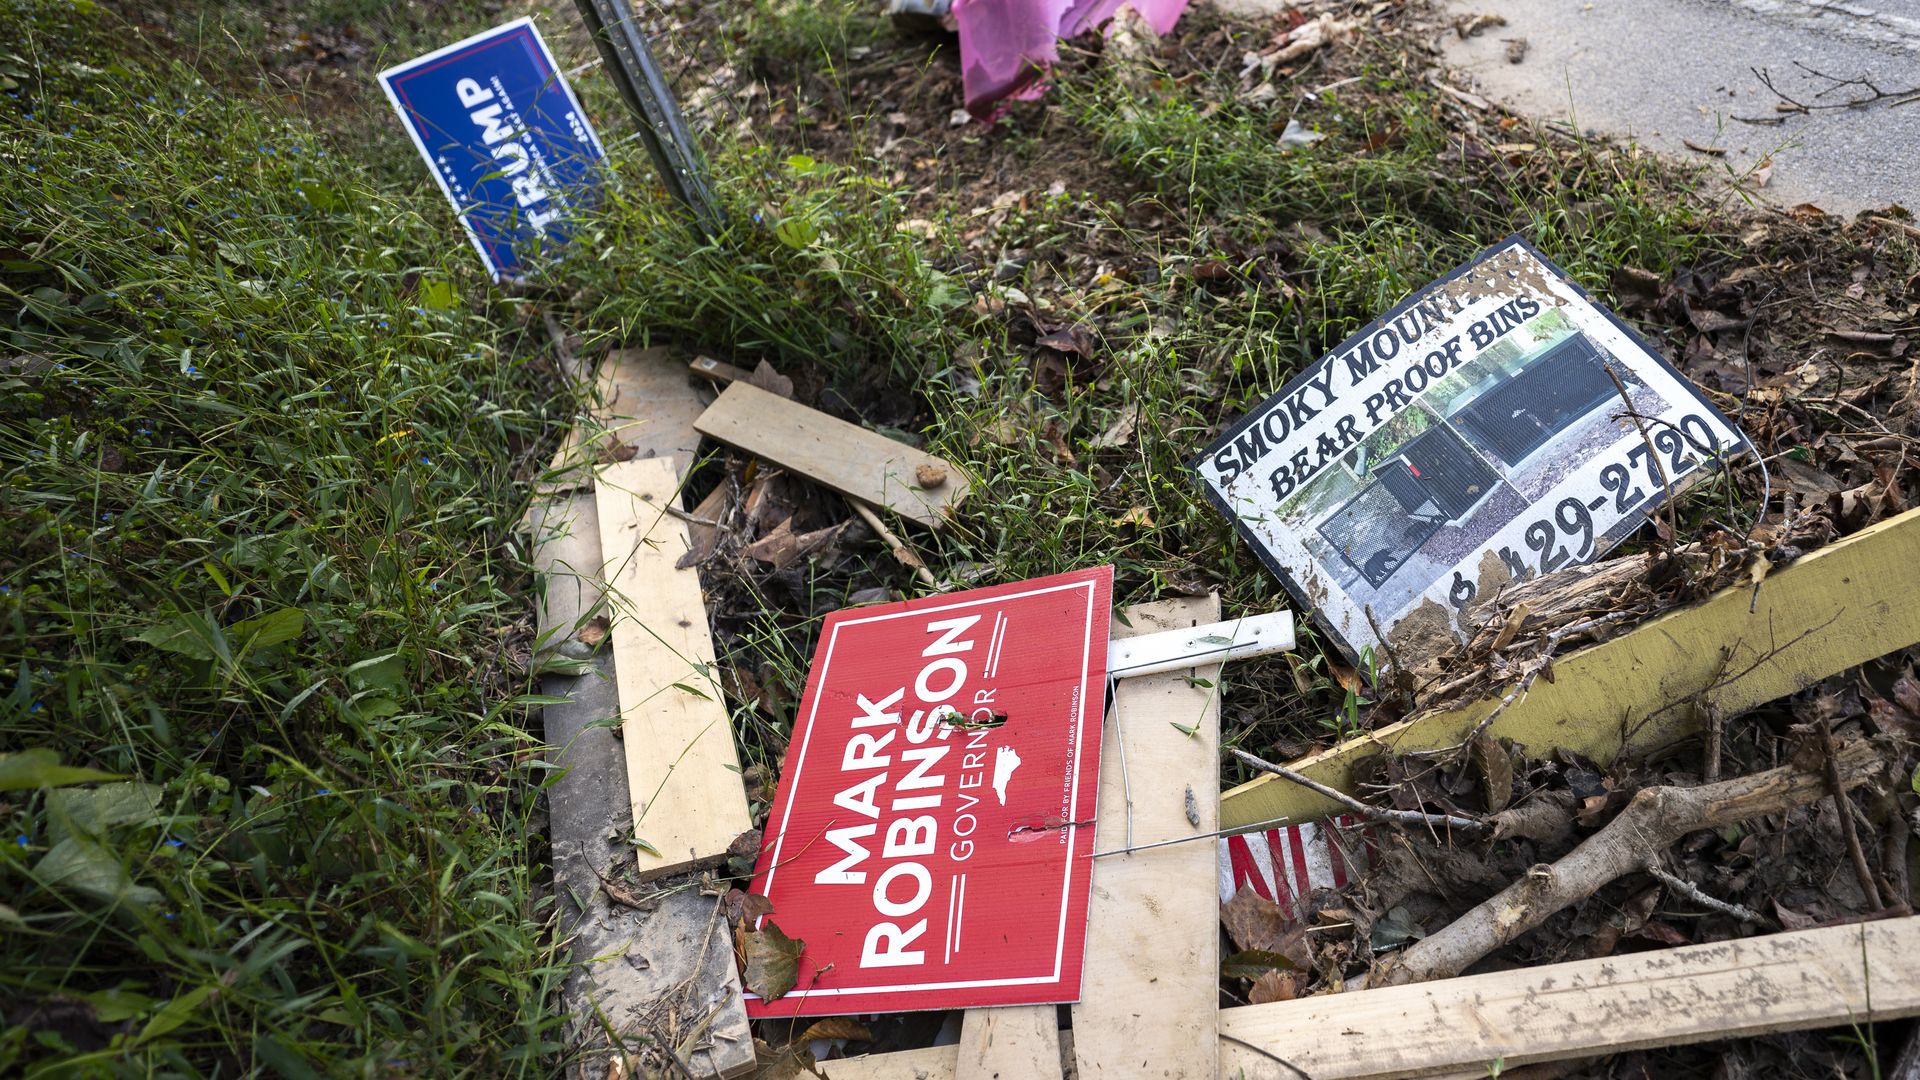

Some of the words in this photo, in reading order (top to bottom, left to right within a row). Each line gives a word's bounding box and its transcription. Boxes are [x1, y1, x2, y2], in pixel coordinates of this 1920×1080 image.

[564, 110, 590, 142] 2024
[456, 76, 561, 237] TRUMP
[1269, 415, 1368, 502] BEAR
[1365, 340, 1463, 431] PROOF
[1469, 294, 1540, 353] BINS
[1214, 355, 1338, 488] SMOKY
[1070, 684, 1080, 722] ROBINSON
[1067, 746, 1074, 757] OF
[1068, 723, 1076, 745] MARK
[813, 686, 906, 885] MARK
[859, 614, 982, 969] ROBINSON
[950, 687, 997, 861] GOVERNOR
[1064, 759, 1073, 792] FRIENDS
[1061, 805, 1069, 822] FOR
[1063, 793, 1070, 804] BY
[1060, 826, 1068, 844] PAID
